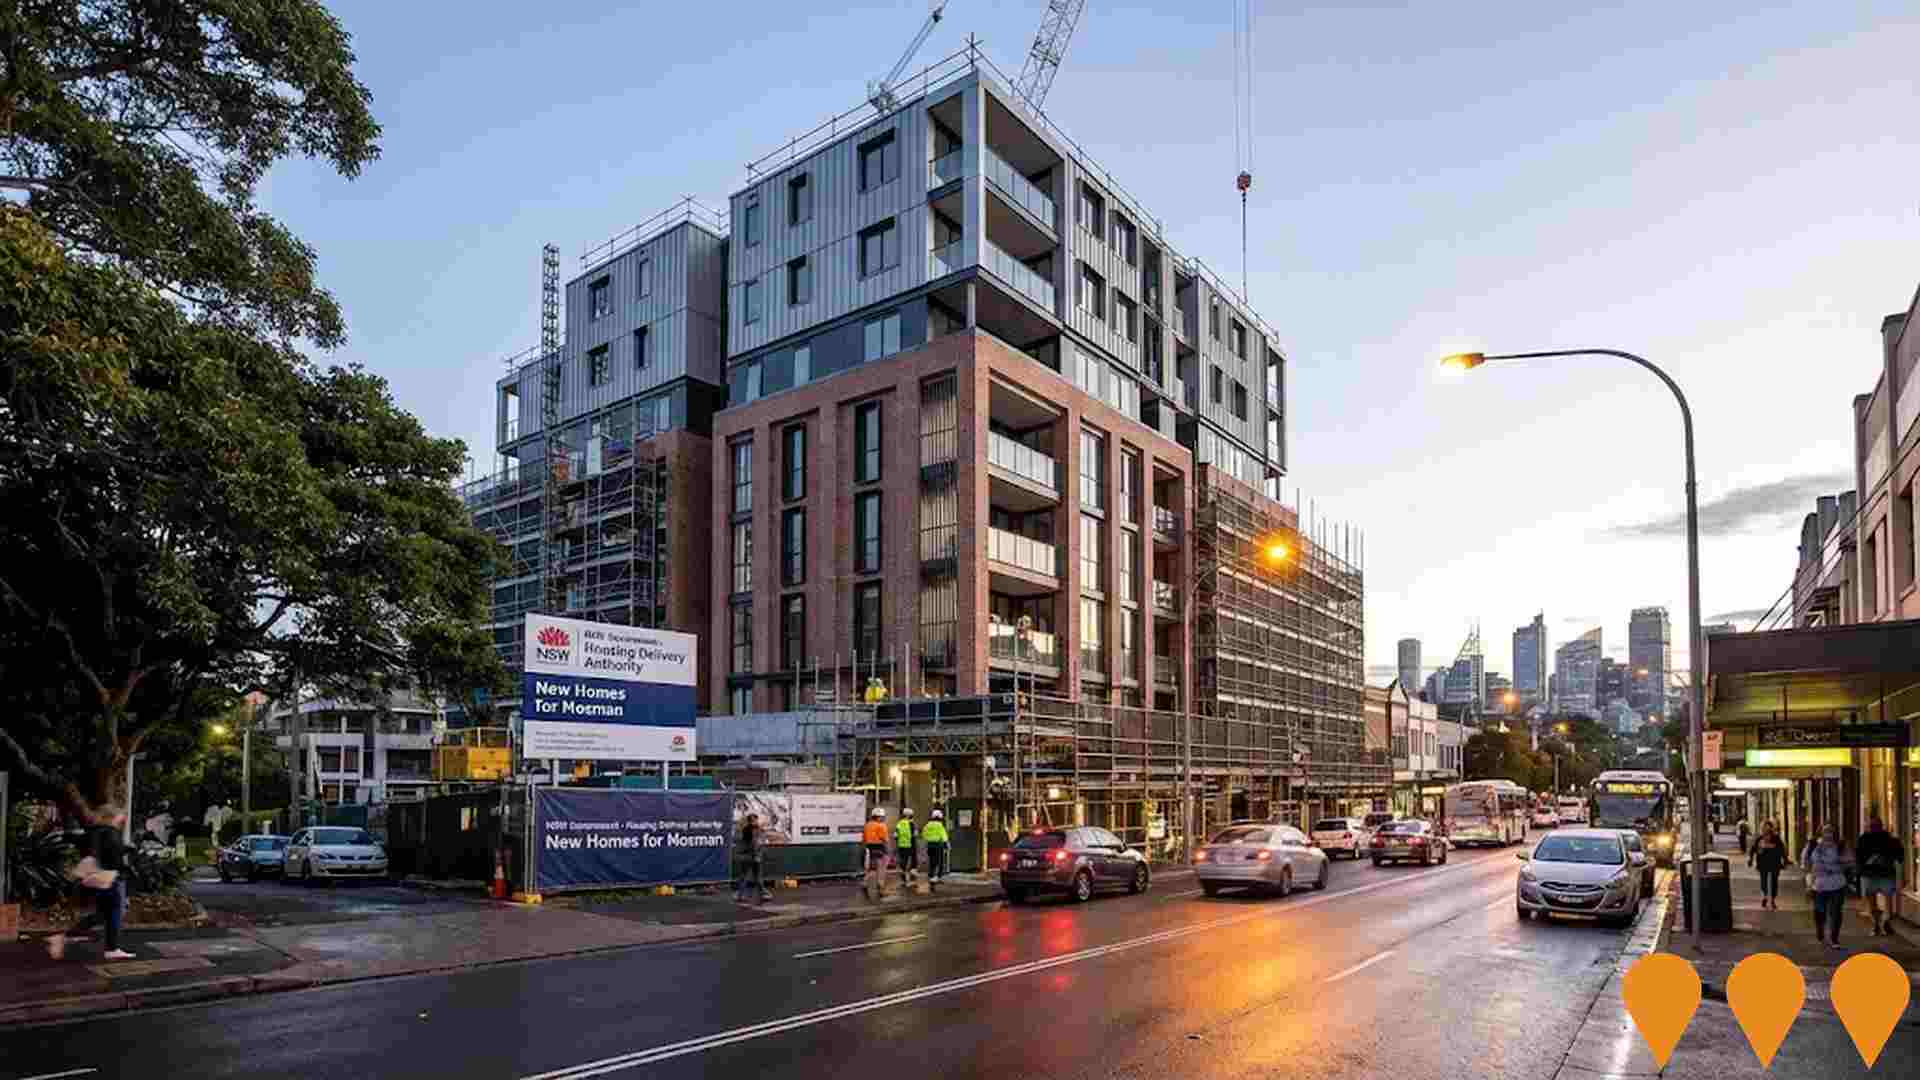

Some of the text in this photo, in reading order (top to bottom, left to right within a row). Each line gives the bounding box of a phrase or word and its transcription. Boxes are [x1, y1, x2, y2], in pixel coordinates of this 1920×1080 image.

[536, 648, 569, 661] NSW
[536, 681, 627, 700] New Homes
[545, 834, 583, 849] New
[587, 833, 640, 849] Homes
[643, 833, 664, 848] for
